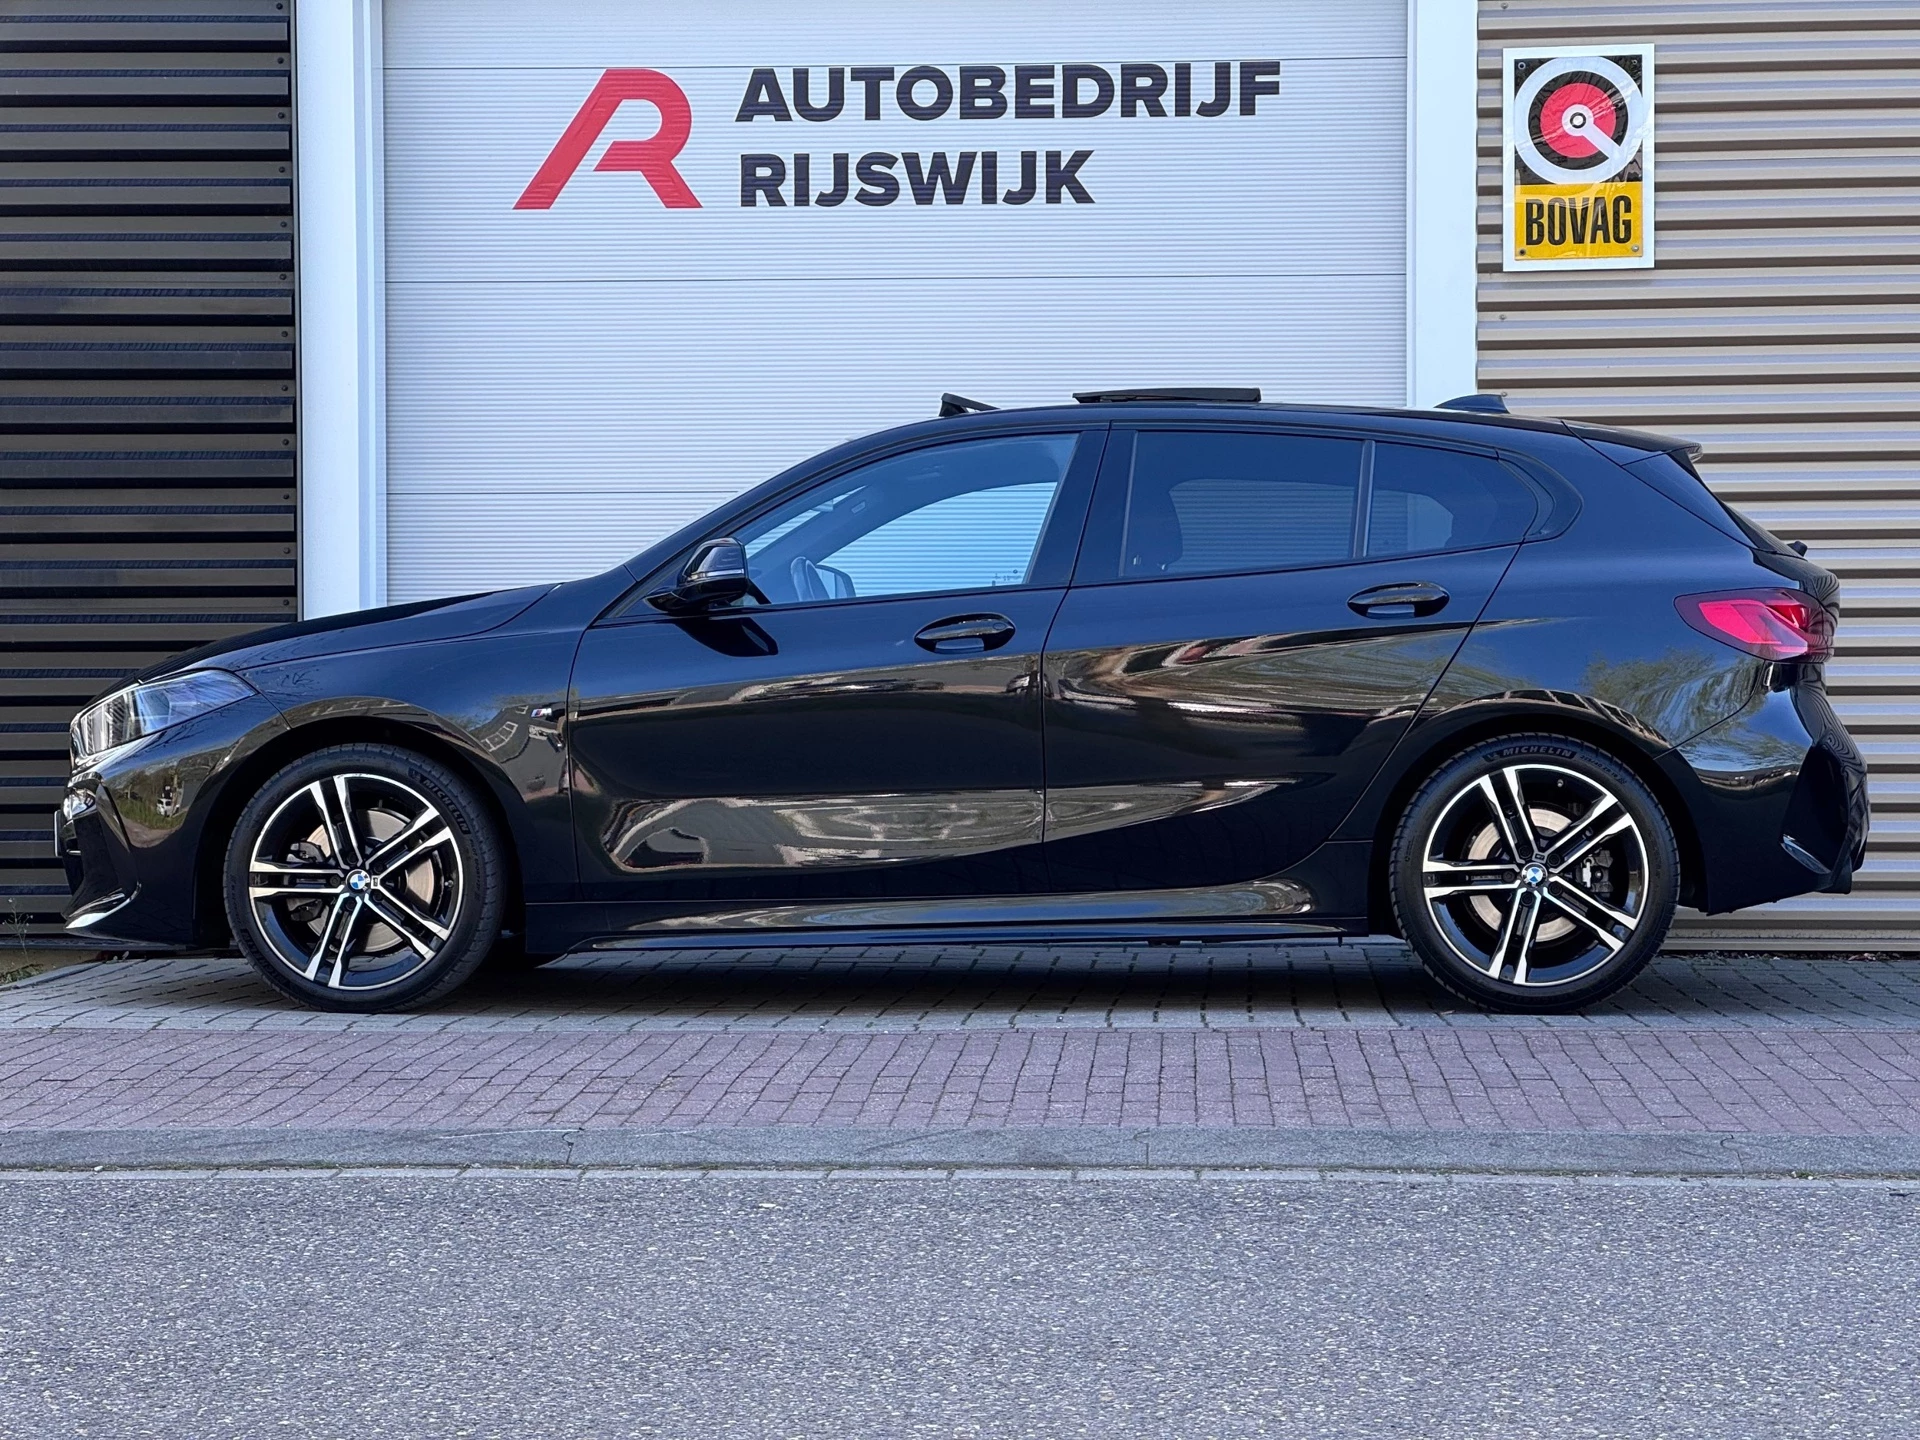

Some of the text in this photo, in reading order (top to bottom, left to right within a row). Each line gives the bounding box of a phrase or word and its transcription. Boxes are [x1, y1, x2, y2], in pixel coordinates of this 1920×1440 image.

[734, 61, 1280, 122] AUTOBEDRIJF
[739, 150, 1095, 208] RIJSWIJK
[1525, 195, 1632, 246] BOVAG
[1502, 745, 1571, 757] MICHELIN
[423, 779, 470, 834] MICHELIN
